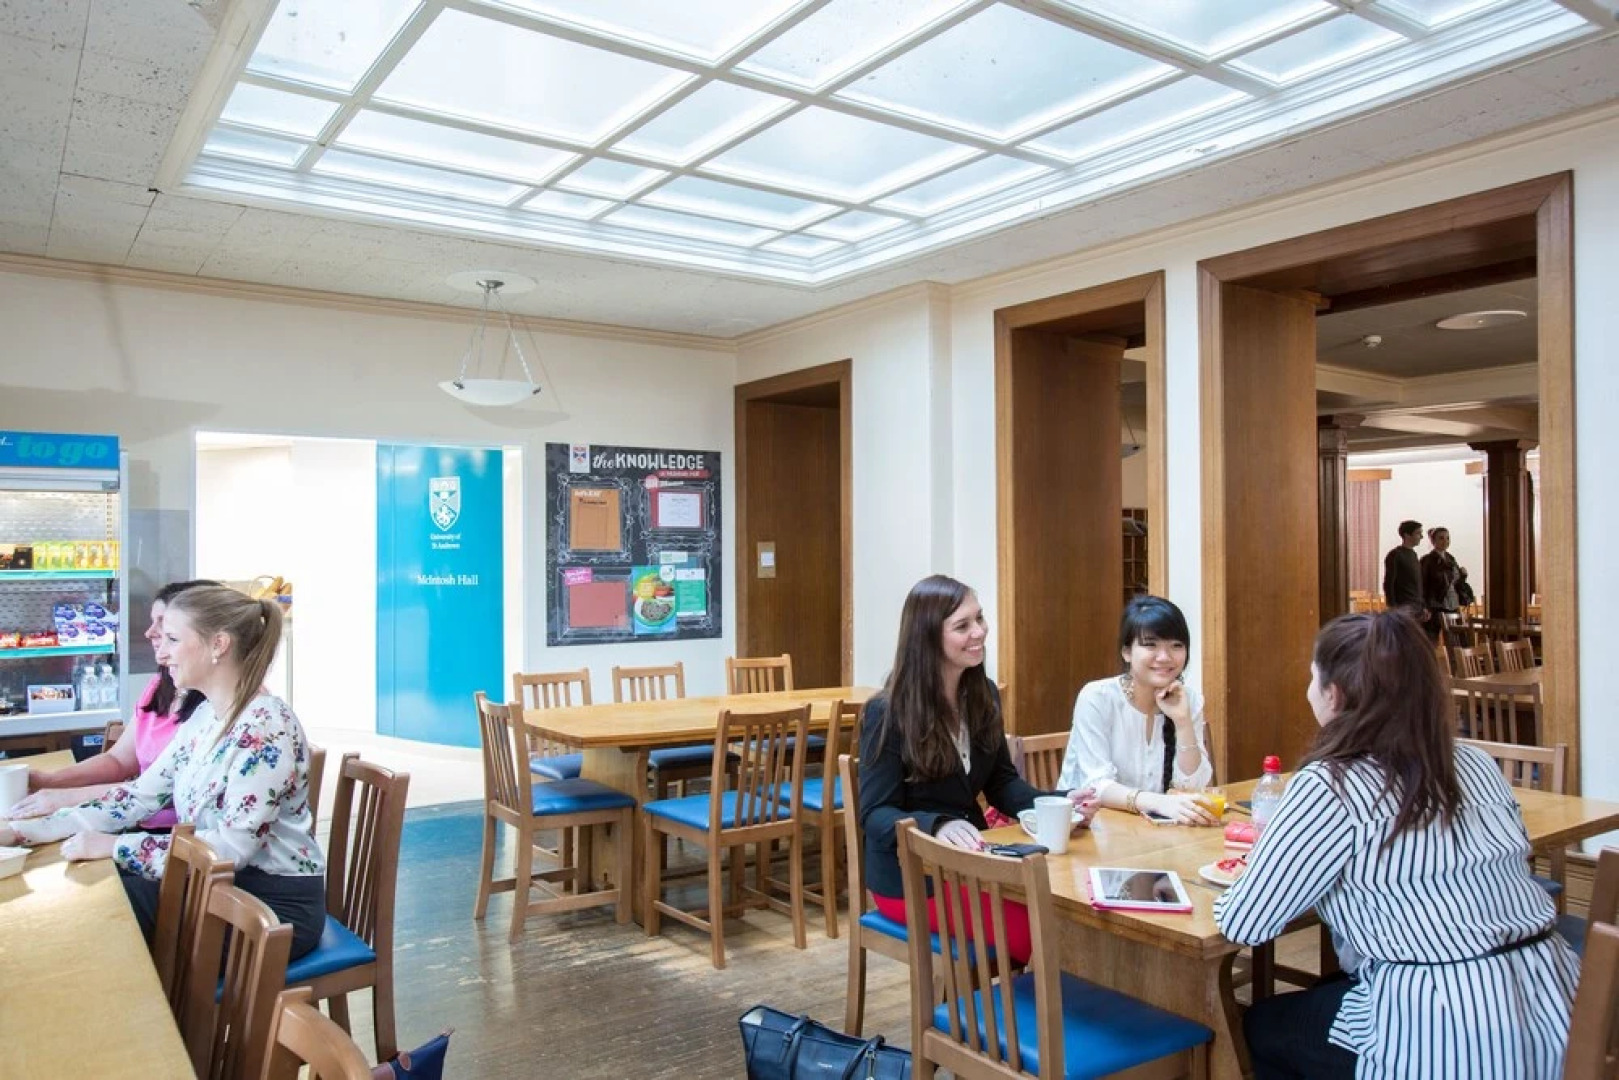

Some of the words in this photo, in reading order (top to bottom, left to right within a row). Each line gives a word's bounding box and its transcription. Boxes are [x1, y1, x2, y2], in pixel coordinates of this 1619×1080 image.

[18, 435, 56, 459] to
[58, 441, 109, 465] go
[592, 451, 615, 469] the
[615, 453, 705, 470] KNOWLEDGE
[416, 574, 456, 585] McIntosh
[457, 574, 479, 585] Hall
